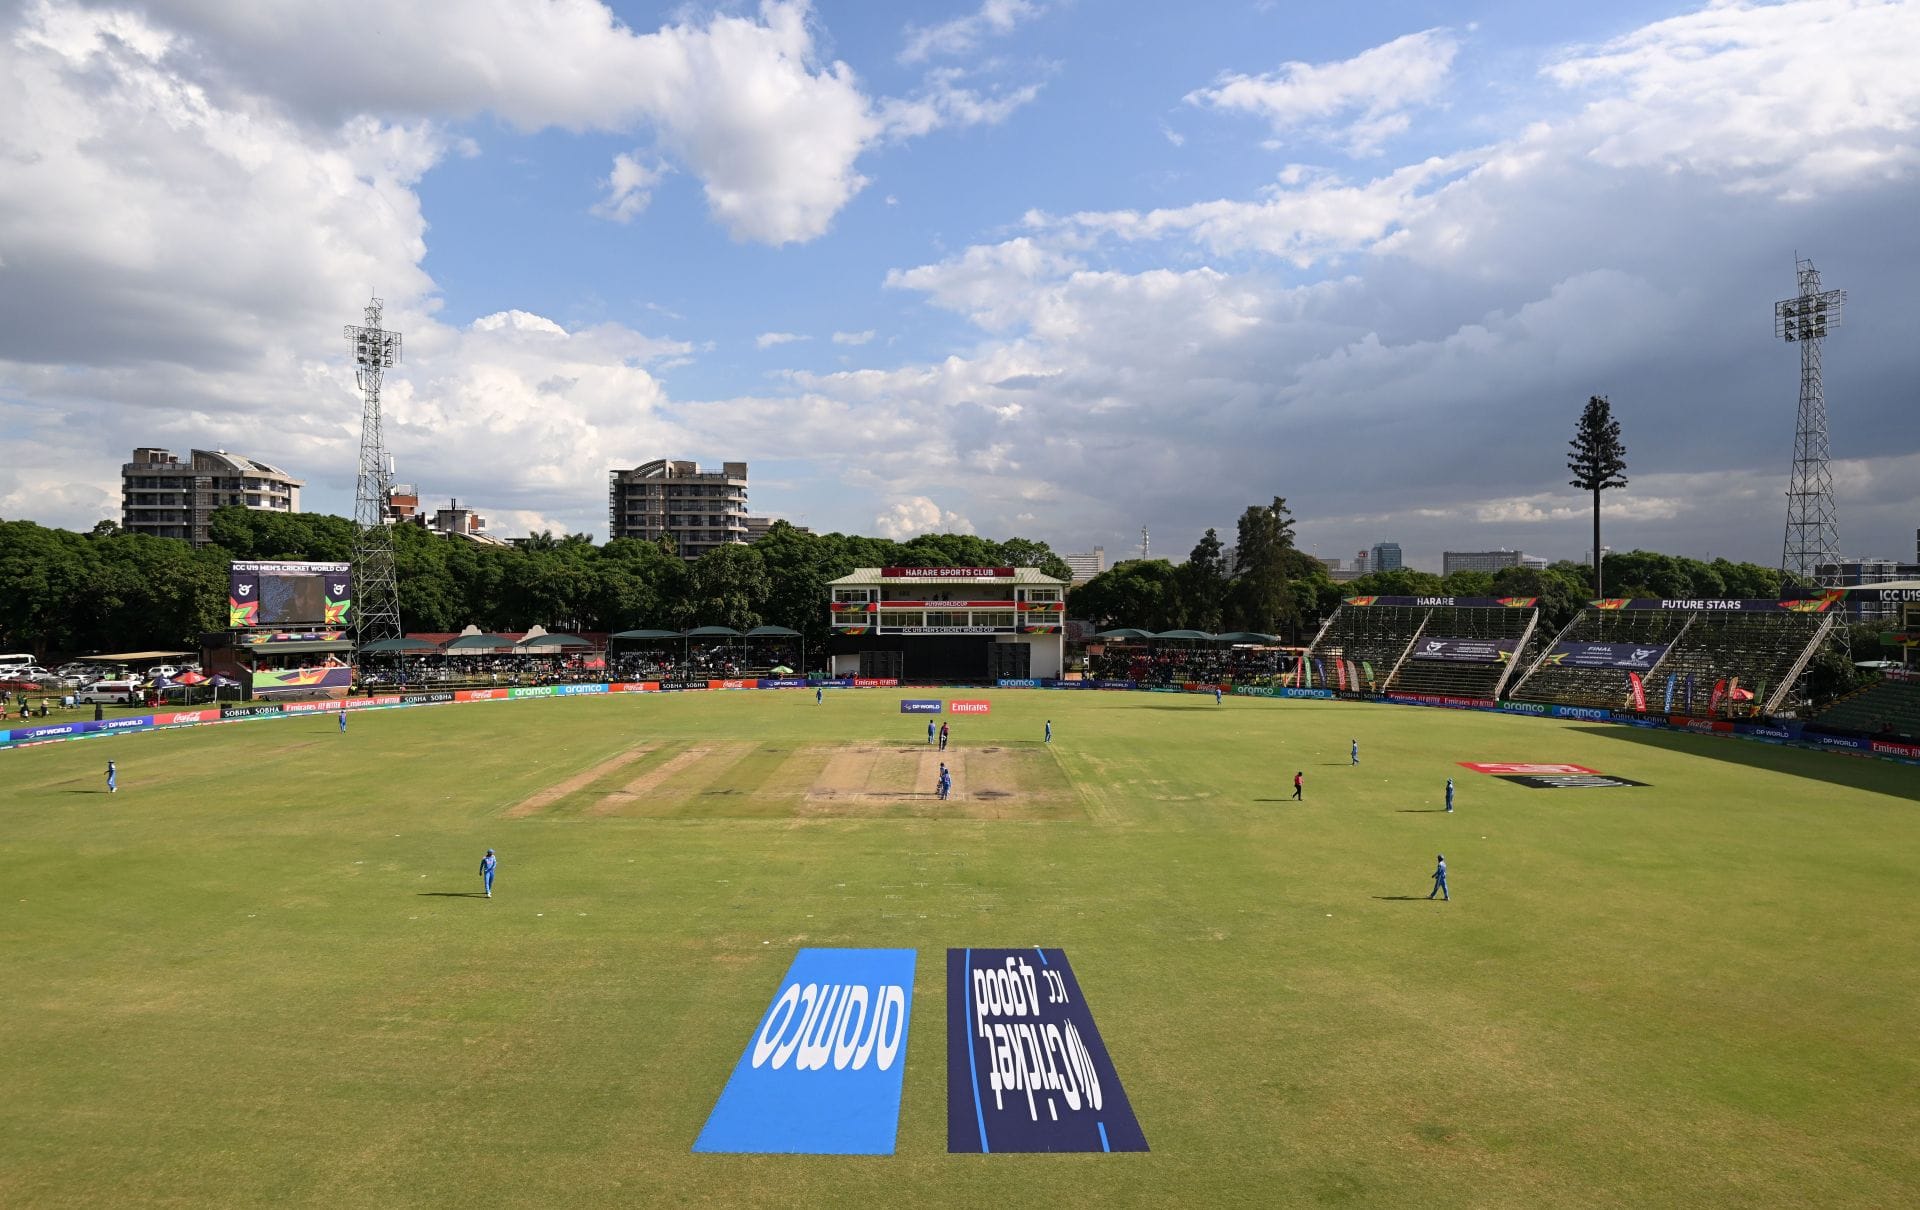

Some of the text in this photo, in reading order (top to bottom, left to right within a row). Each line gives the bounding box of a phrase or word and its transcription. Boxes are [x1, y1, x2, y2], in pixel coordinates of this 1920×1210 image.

[1880, 590, 1900, 600] ICC
[1417, 598, 1454, 606] HARARE
[1662, 600, 1741, 610] FUTURE STARS
[515, 687, 552, 696] aramco
[566, 684, 602, 693] aramco
[1238, 684, 1274, 694] aramco
[1288, 688, 1324, 697] aramco
[952, 703, 988, 711] Emirates
[1504, 702, 1544, 712] aramco
[224, 709, 250, 717] SOBHA
[1560, 707, 1601, 718] aramco
[1834, 739, 1858, 747] WORLD
[1873, 743, 1909, 756] Emirates
[1042, 970, 1069, 1004] ICC
[751, 983, 905, 1071] aramco
[983, 1023, 1081, 1121] Cricket
